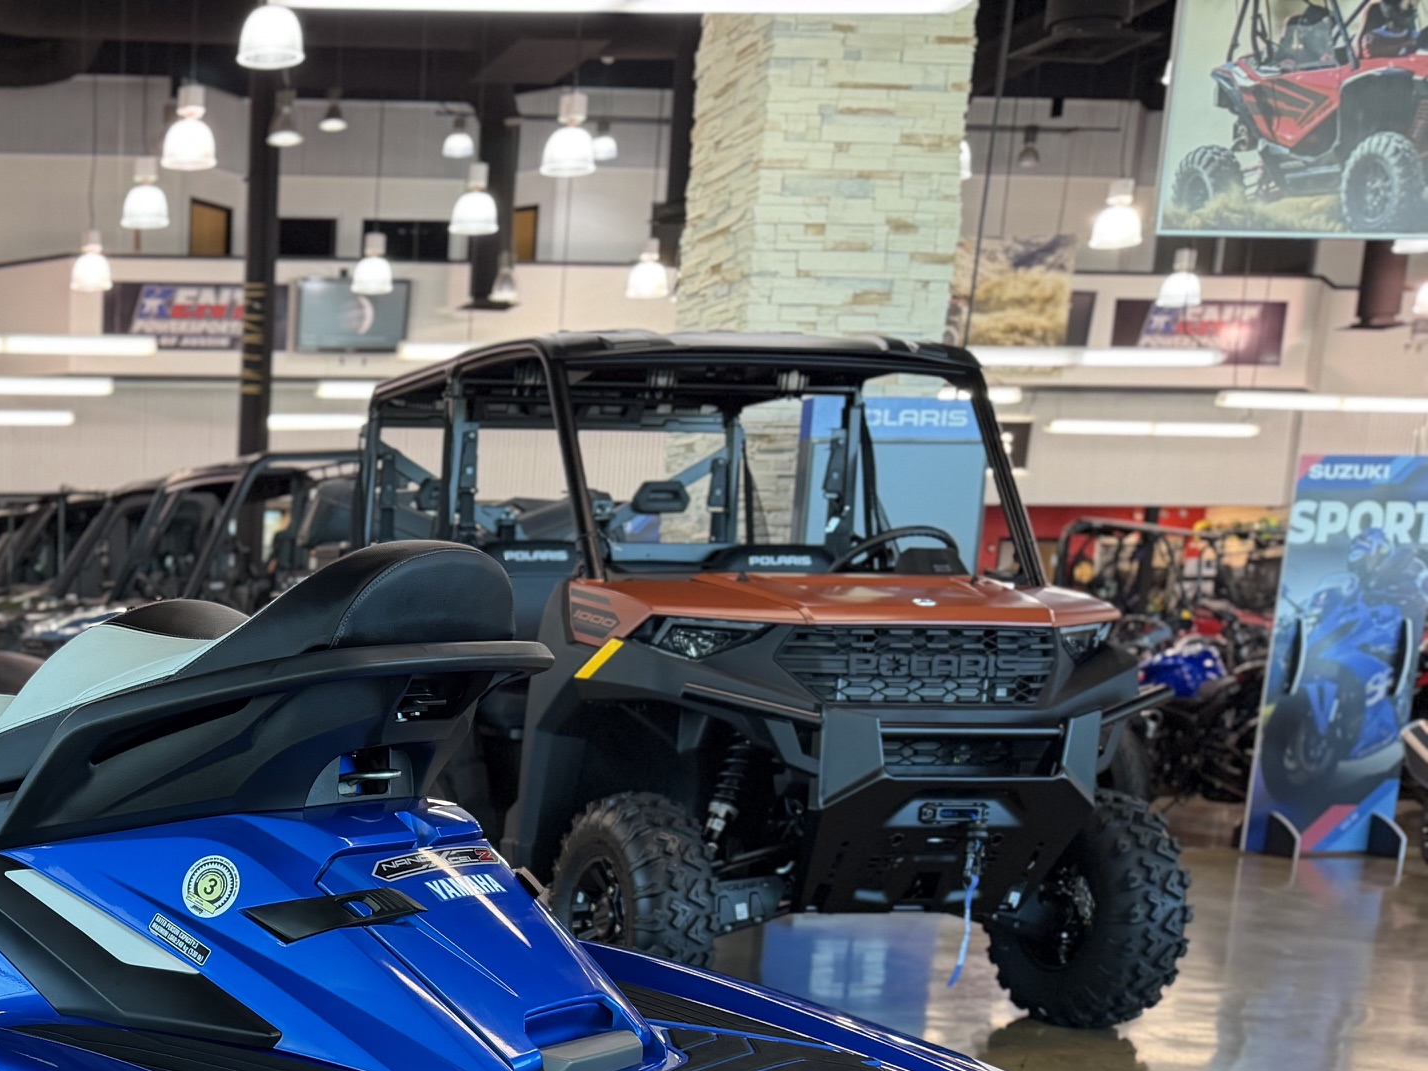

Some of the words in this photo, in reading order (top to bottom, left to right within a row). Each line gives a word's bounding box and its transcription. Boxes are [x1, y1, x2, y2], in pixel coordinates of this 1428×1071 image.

[865, 409, 968, 427] OLARIS
[1308, 463, 1391, 480] SUZUKI
[503, 550, 568, 562] POLARIS
[749, 555, 812, 566] POLARIS
[573, 609, 618, 629] 1000
[848, 653, 1021, 677] POLARIS
[204, 878, 217, 895] 3
[424, 873, 507, 900] YAMAHA
